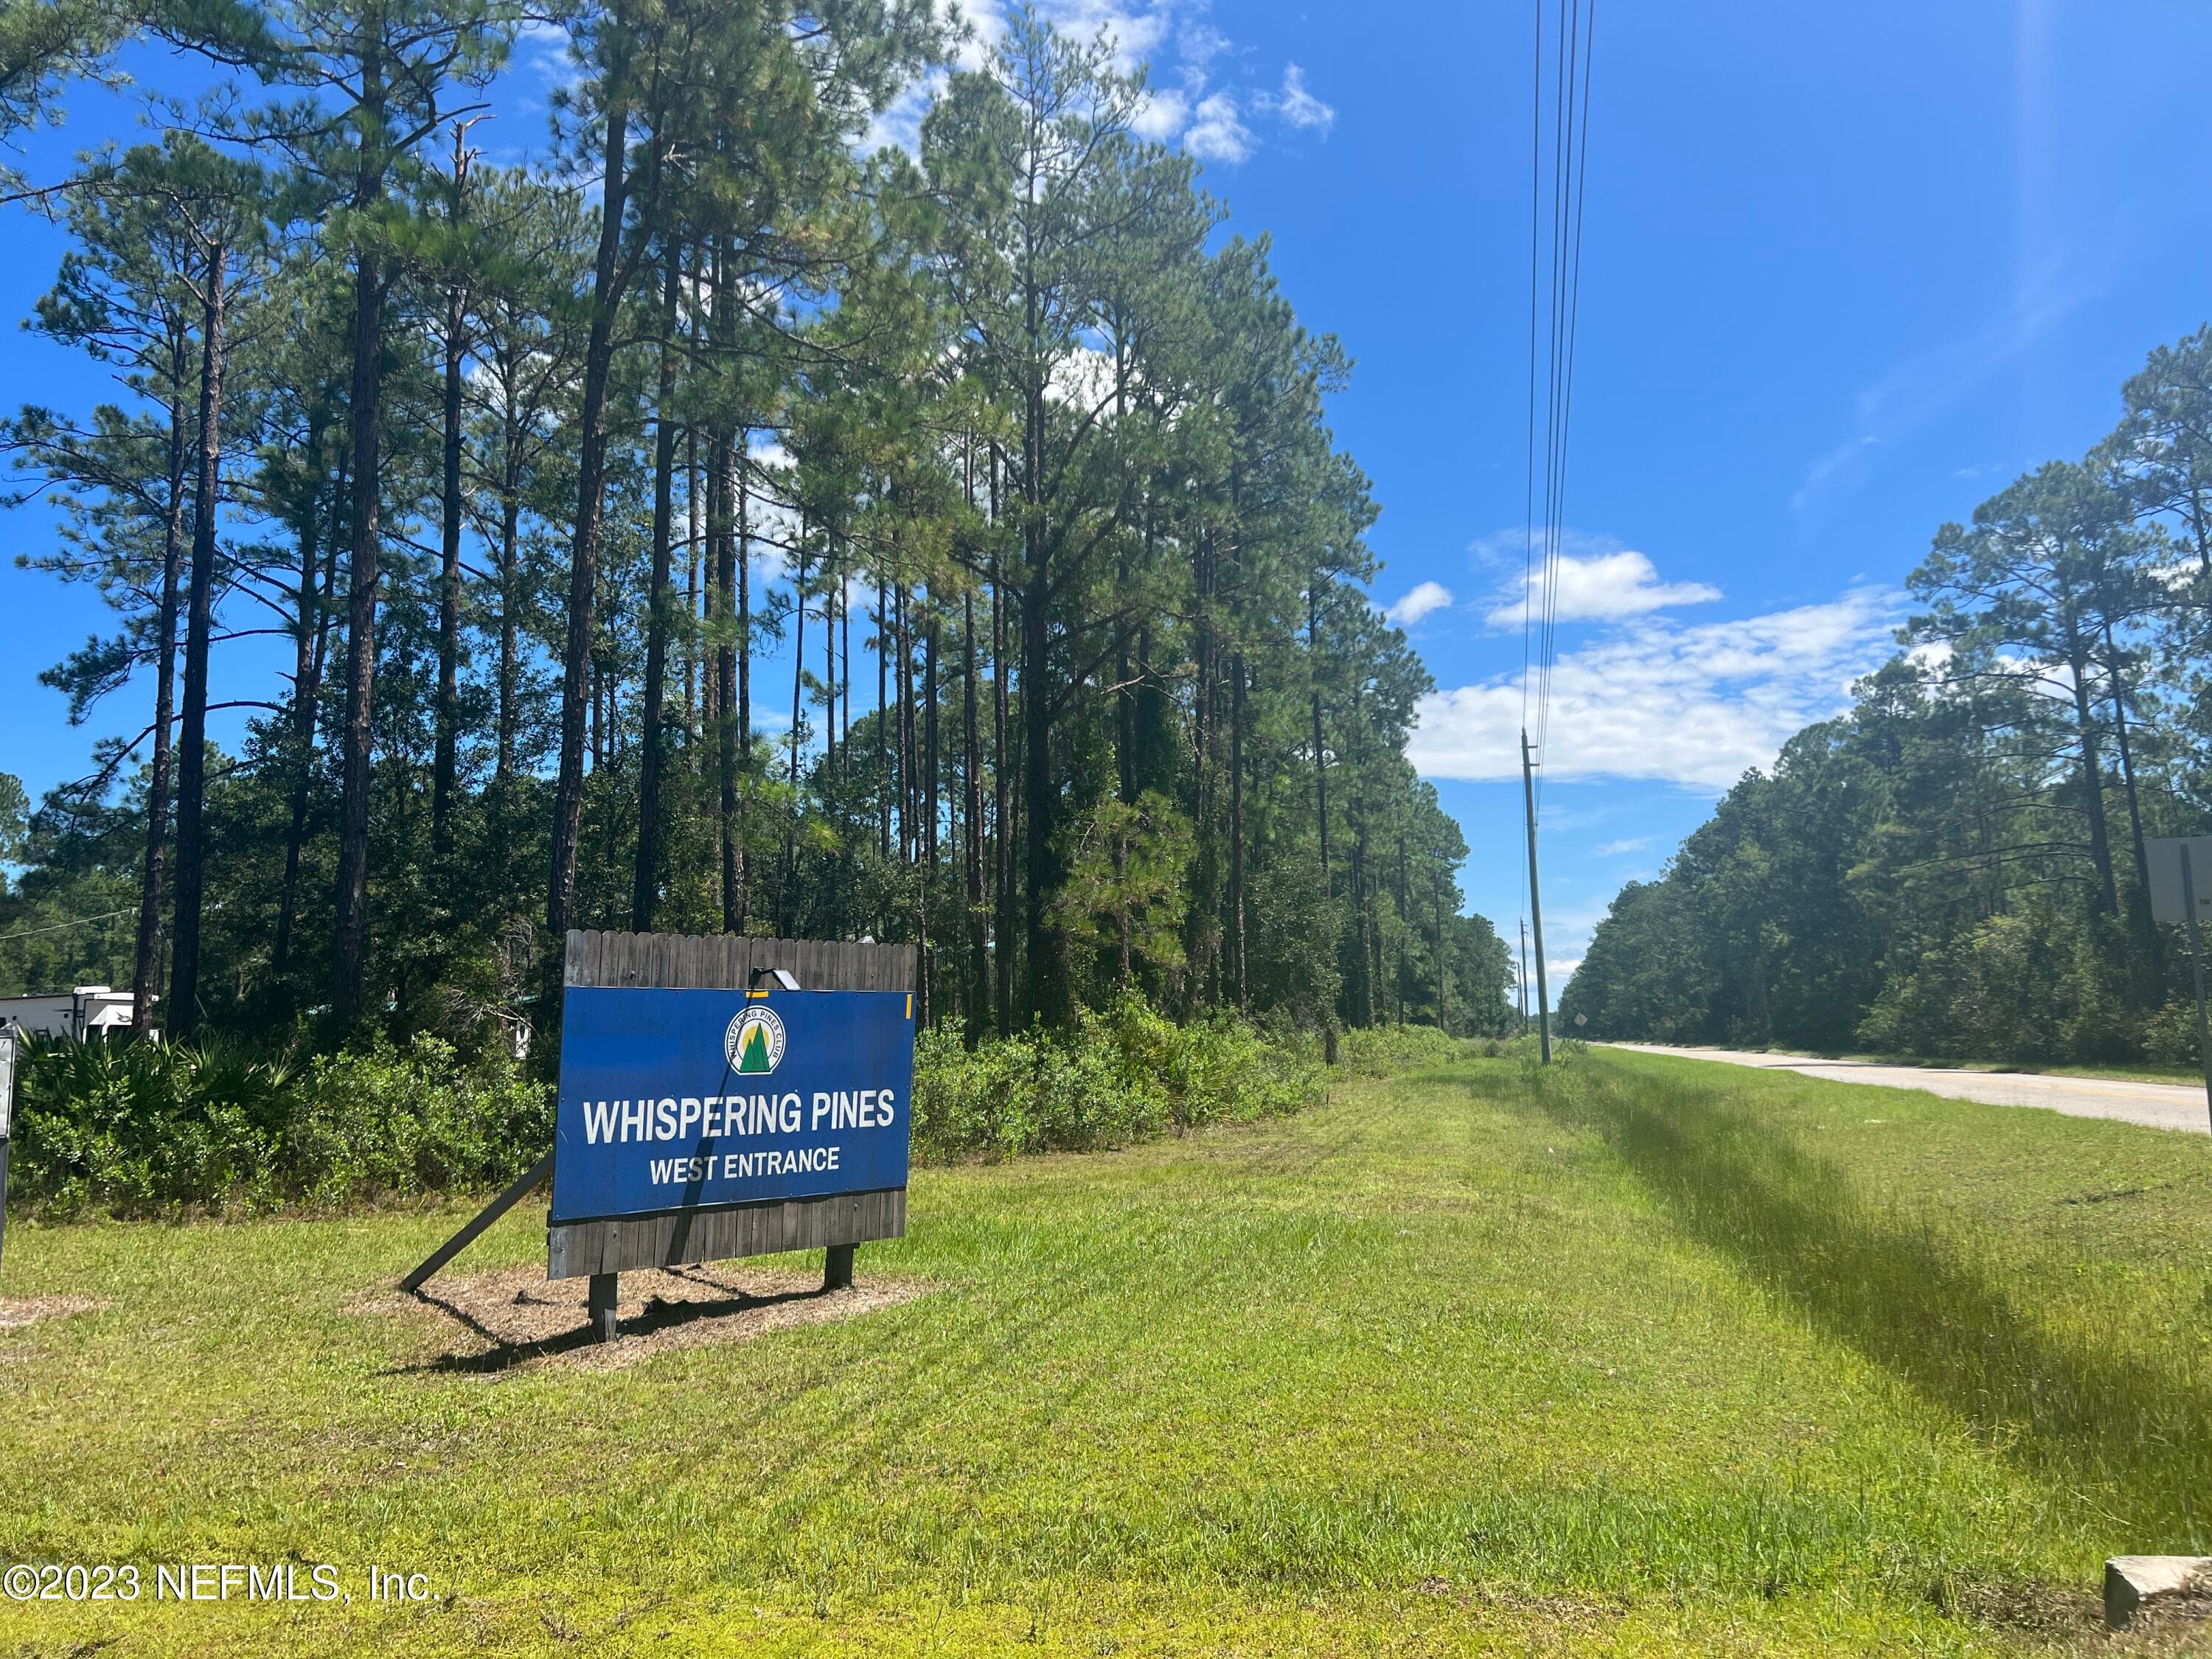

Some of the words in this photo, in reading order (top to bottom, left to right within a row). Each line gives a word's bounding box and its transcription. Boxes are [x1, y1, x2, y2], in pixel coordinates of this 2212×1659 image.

[728, 1011, 757, 1060] WHISPERING
[760, 1011, 779, 1030] PINES
[773, 1033, 782, 1058] CLUB
[582, 1094, 801, 1144] WHISPERING
[812, 1089, 894, 1130] PINES
[650, 1155, 717, 1185] WEST
[724, 1147, 840, 1179] ENTRANCE
